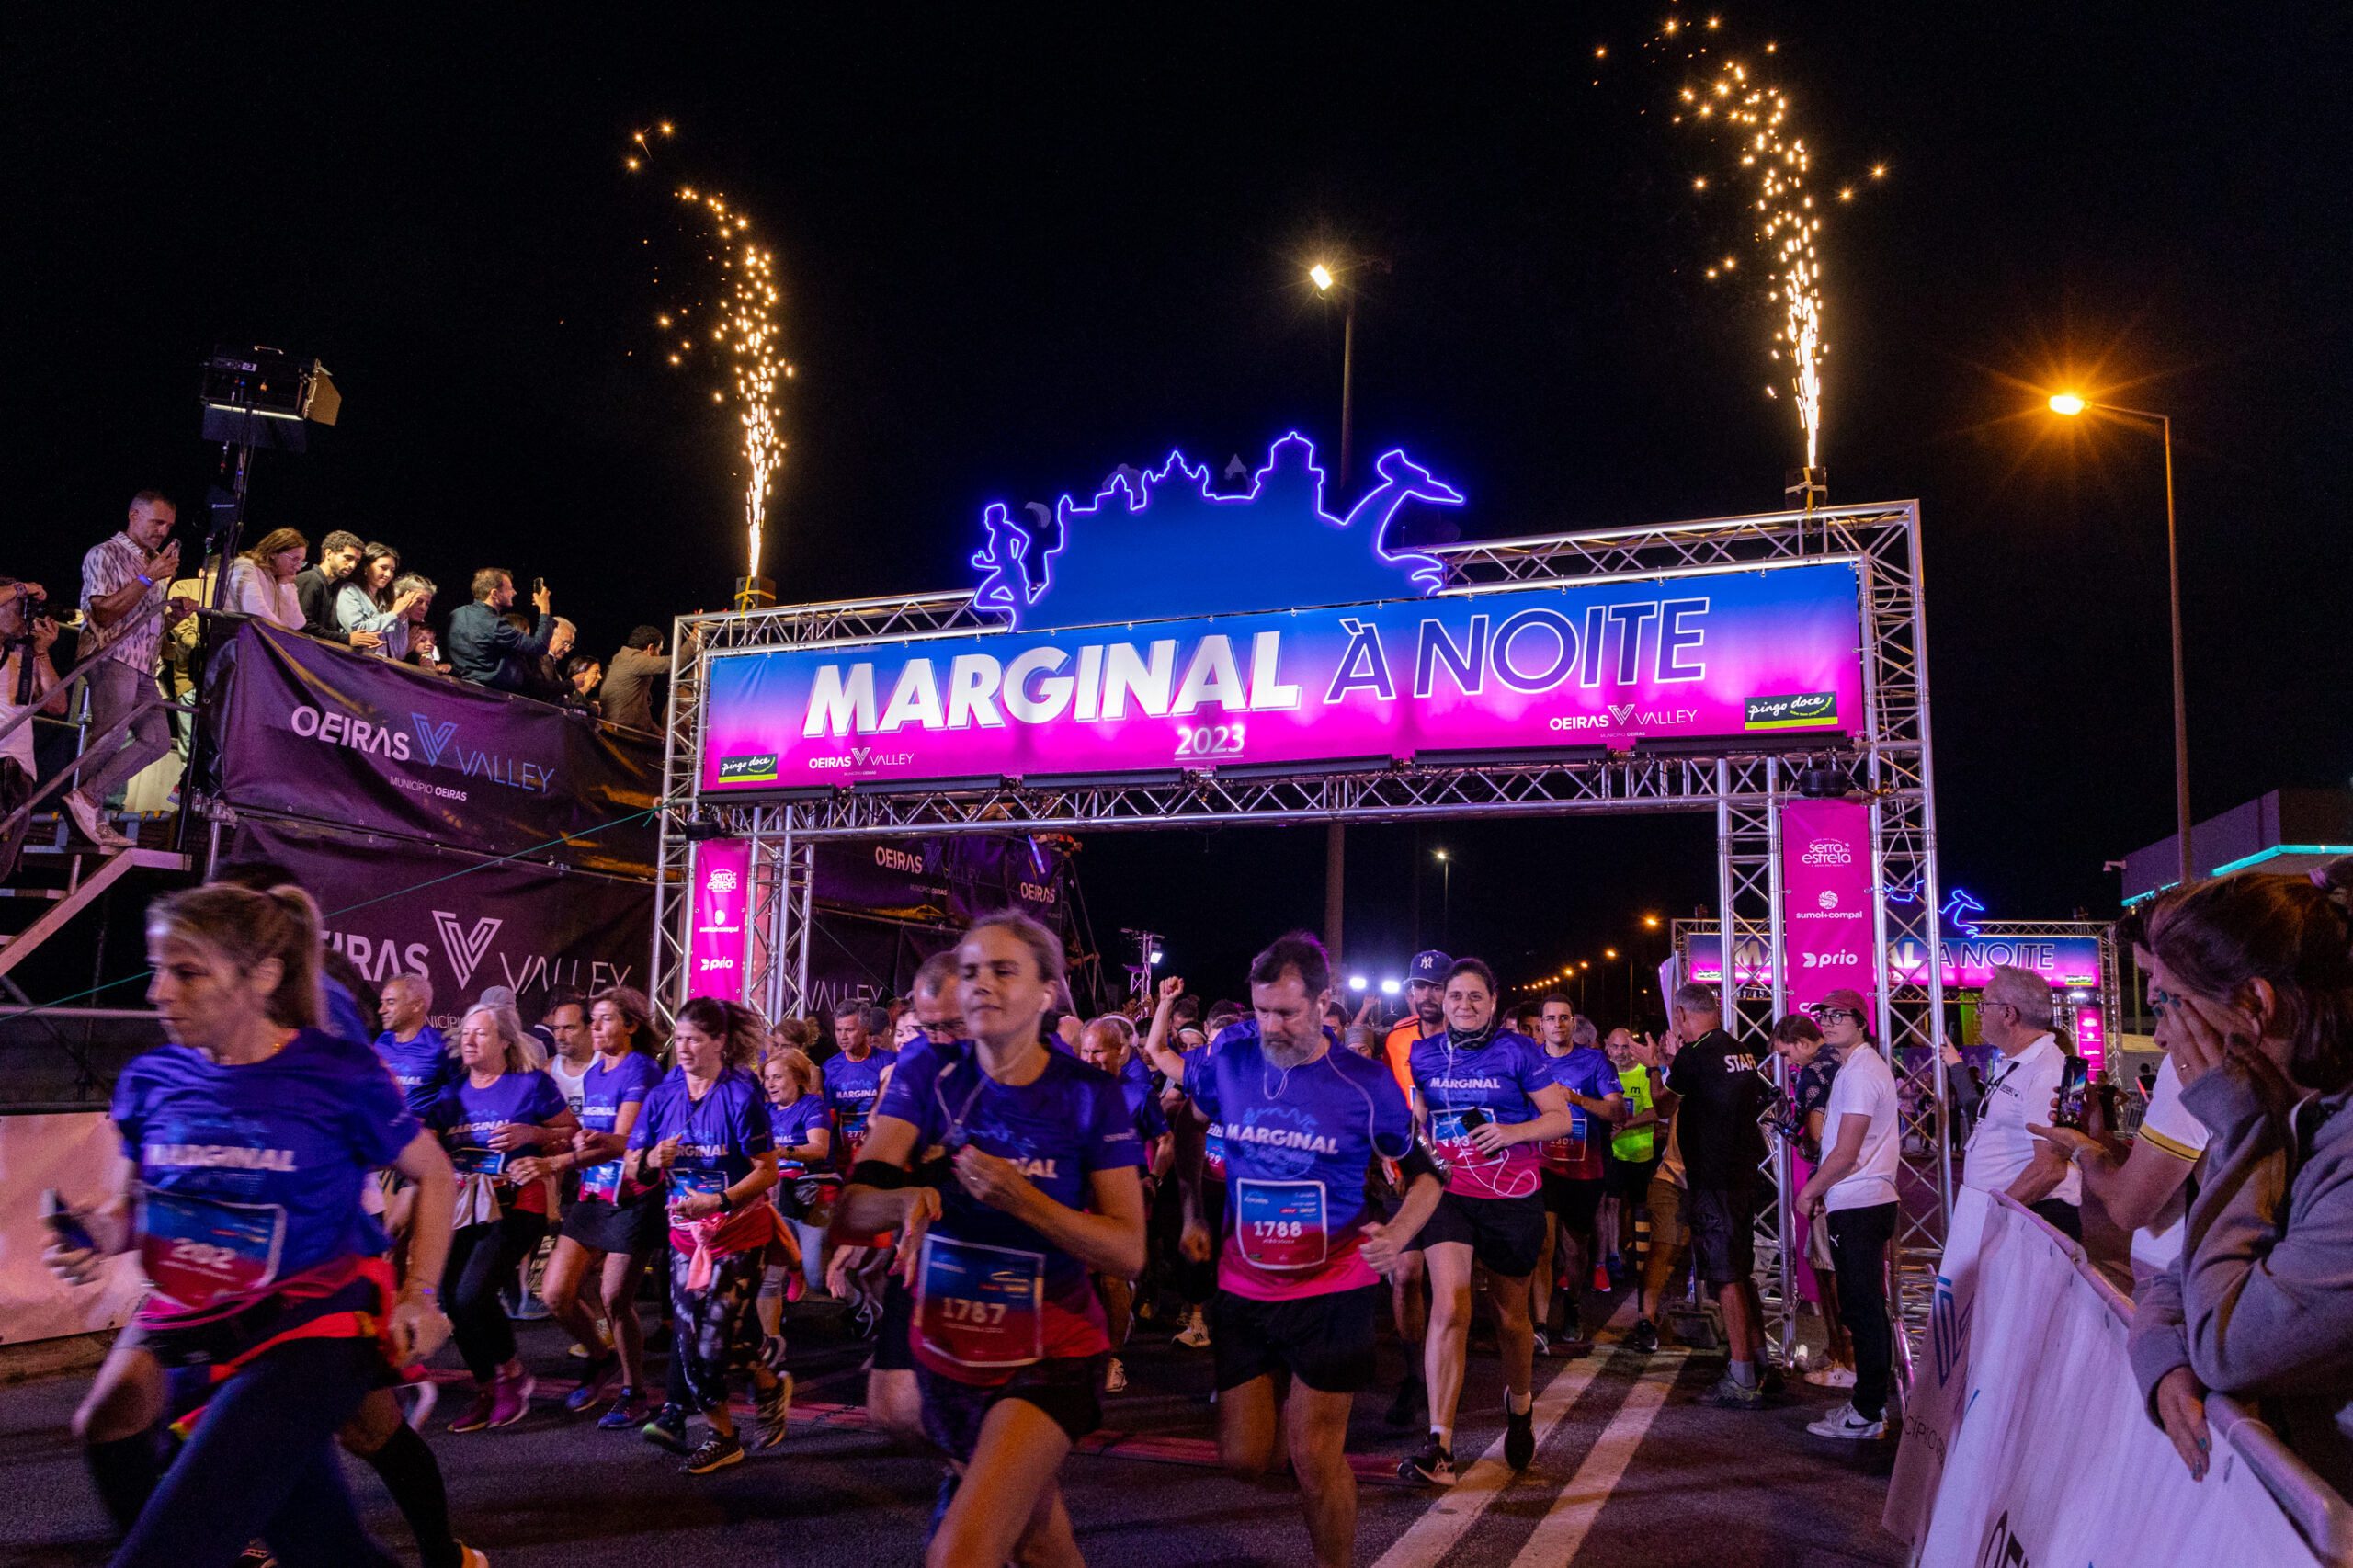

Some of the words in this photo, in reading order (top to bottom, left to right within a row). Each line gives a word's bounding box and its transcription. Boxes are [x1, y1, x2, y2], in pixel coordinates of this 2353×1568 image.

[802, 631, 1302, 738] MARGINAL
[1323, 618, 1397, 705] À
[1413, 597, 1711, 699] NOITE
[1748, 701, 1788, 721] pingo
[1790, 696, 1824, 709] doce
[1550, 714, 1608, 730] OEIRAS
[1635, 709, 1698, 725] VALLEY
[291, 705, 410, 761] OEIRAS
[456, 745, 555, 793] VALLEY
[1174, 724, 1245, 756] 2023
[722, 760, 747, 776] pingo
[748, 756, 770, 766] doce
[808, 756, 852, 769] OEIRAS
[870, 753, 915, 766] VALLEY
[390, 775, 433, 795] MUNICÍPIO
[435, 785, 467, 801] OEIRAS
[1802, 852, 1851, 864] estrela
[1809, 843, 1842, 853] serra
[875, 846, 923, 874] OEIRAS
[1020, 881, 1055, 903] OEIRAS
[1796, 910, 1863, 920] sumol+compal
[710, 957, 733, 971] prio
[1818, 949, 1859, 968] prio
[1960, 942, 2055, 970] NOITE
[1430, 1077, 1501, 1089] MARGINAL
[835, 1089, 877, 1099] MARGINA
[1225, 1122, 1340, 1156] MARGINAL
[1254, 1221, 1303, 1238] 1788
[943, 1297, 1008, 1324] 1787
